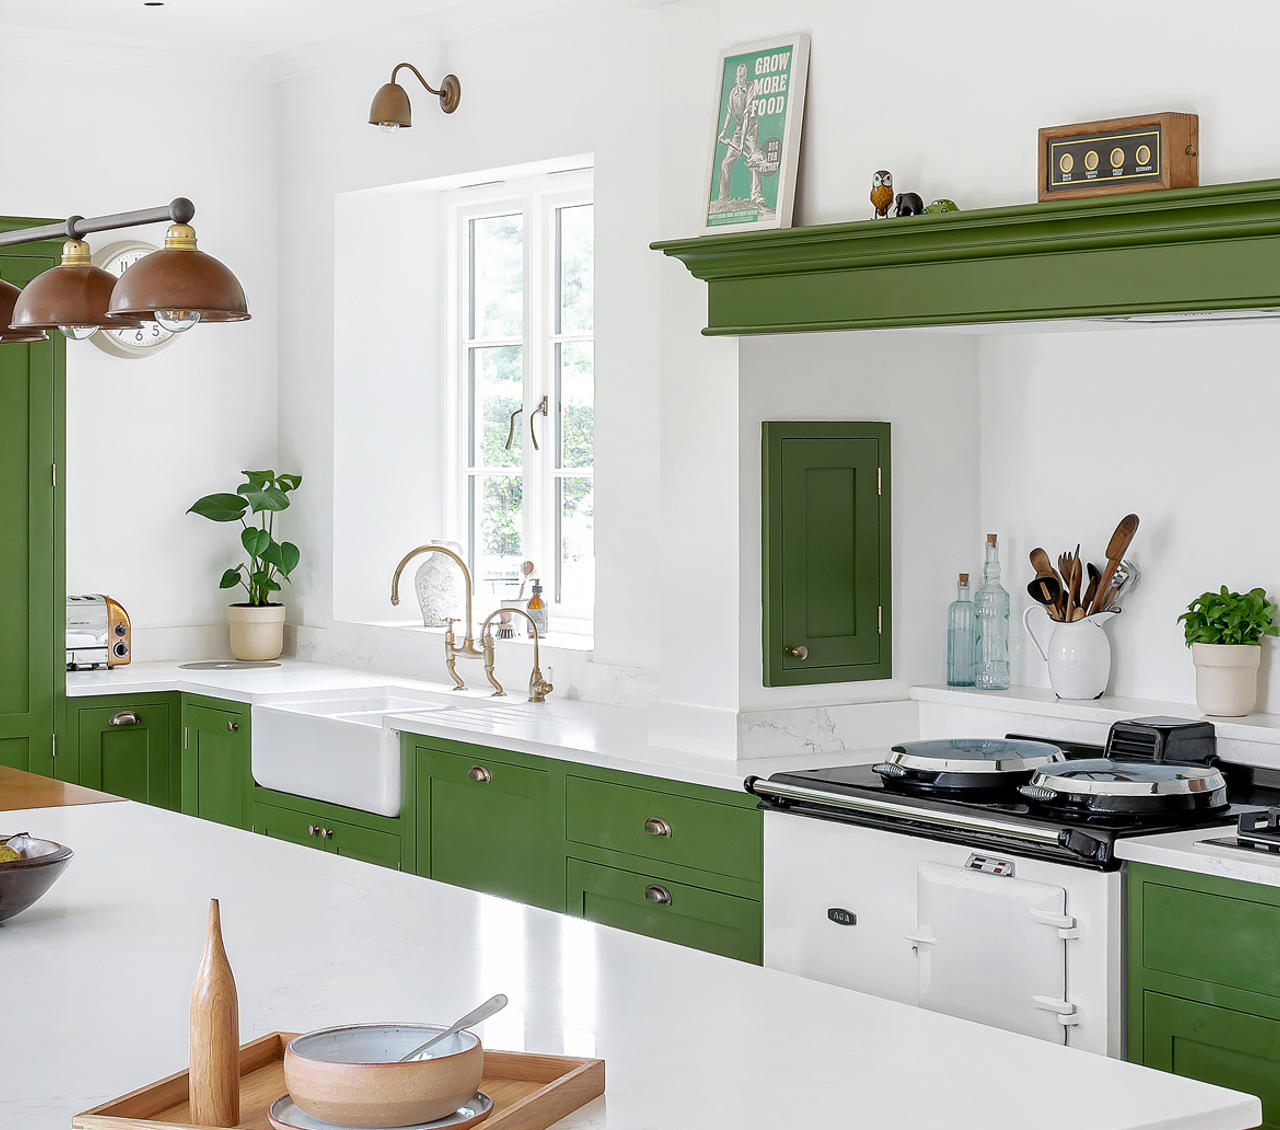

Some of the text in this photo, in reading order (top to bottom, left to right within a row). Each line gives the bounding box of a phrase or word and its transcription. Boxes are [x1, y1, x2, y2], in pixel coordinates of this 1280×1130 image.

[755, 52, 790, 75] GROW
[753, 74, 788, 95] MORE
[750, 96, 785, 117] FOOD
[135, 330, 143, 341] 6
[152, 325, 159, 336] 5
